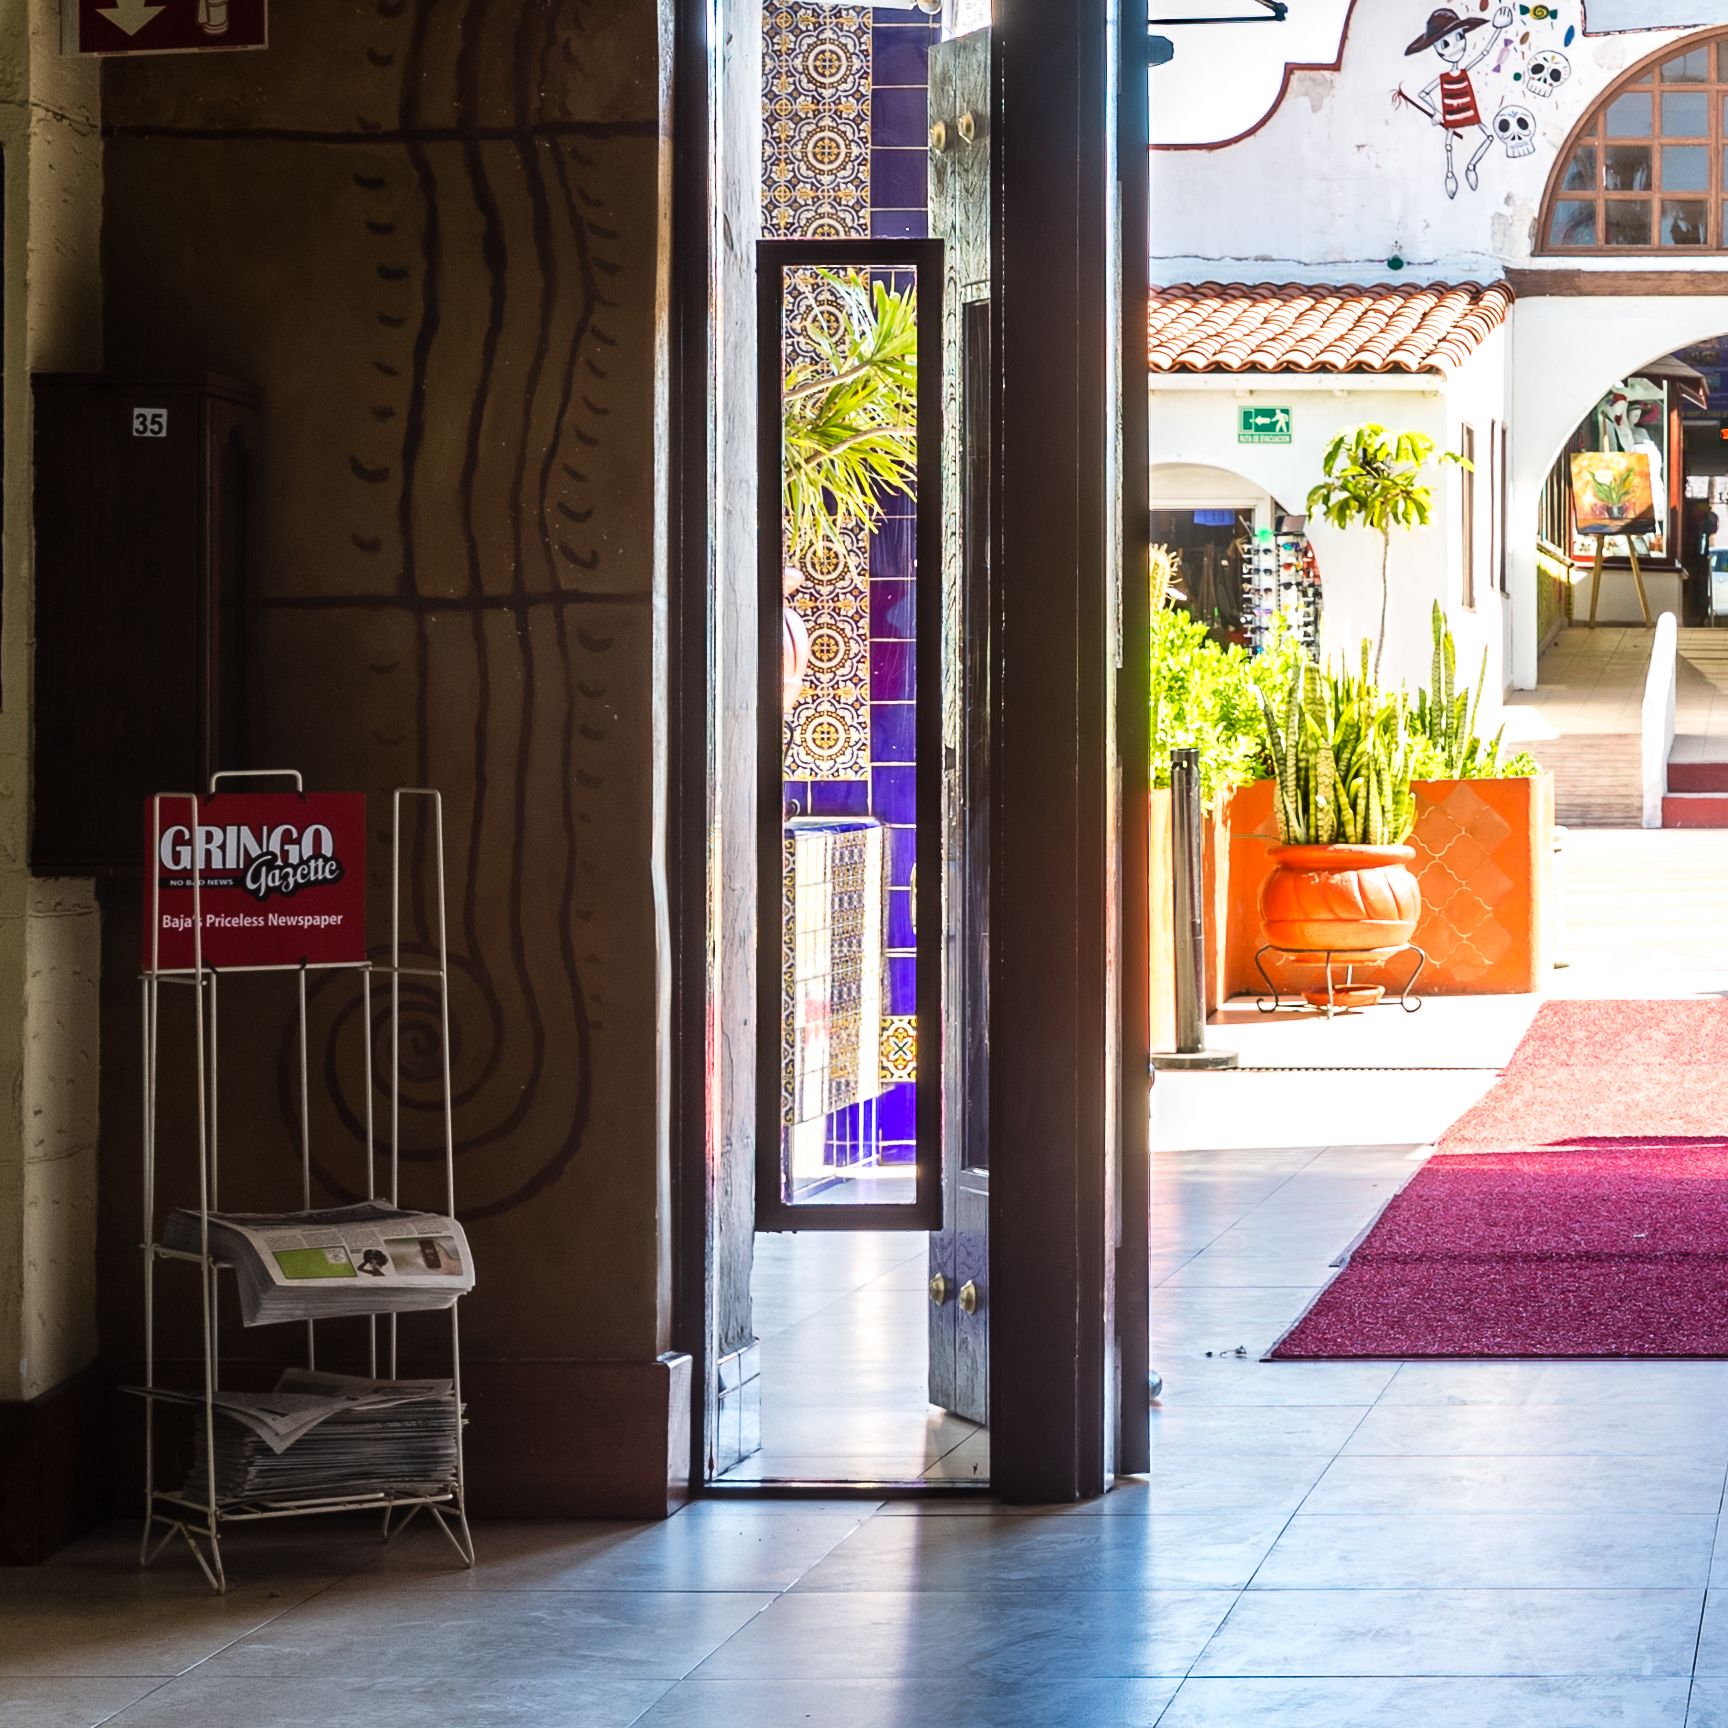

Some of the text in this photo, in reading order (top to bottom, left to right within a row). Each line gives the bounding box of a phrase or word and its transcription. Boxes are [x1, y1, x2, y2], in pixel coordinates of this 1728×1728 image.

[135, 413, 164, 435] 35
[160, 824, 333, 871] GRINGO
[170, 878, 184, 886] NO
[207, 878, 234, 886] NEWS
[246, 854, 339, 897] Gazette
[206, 913, 265, 928] Priceless
[268, 912, 344, 929] Newspaper
